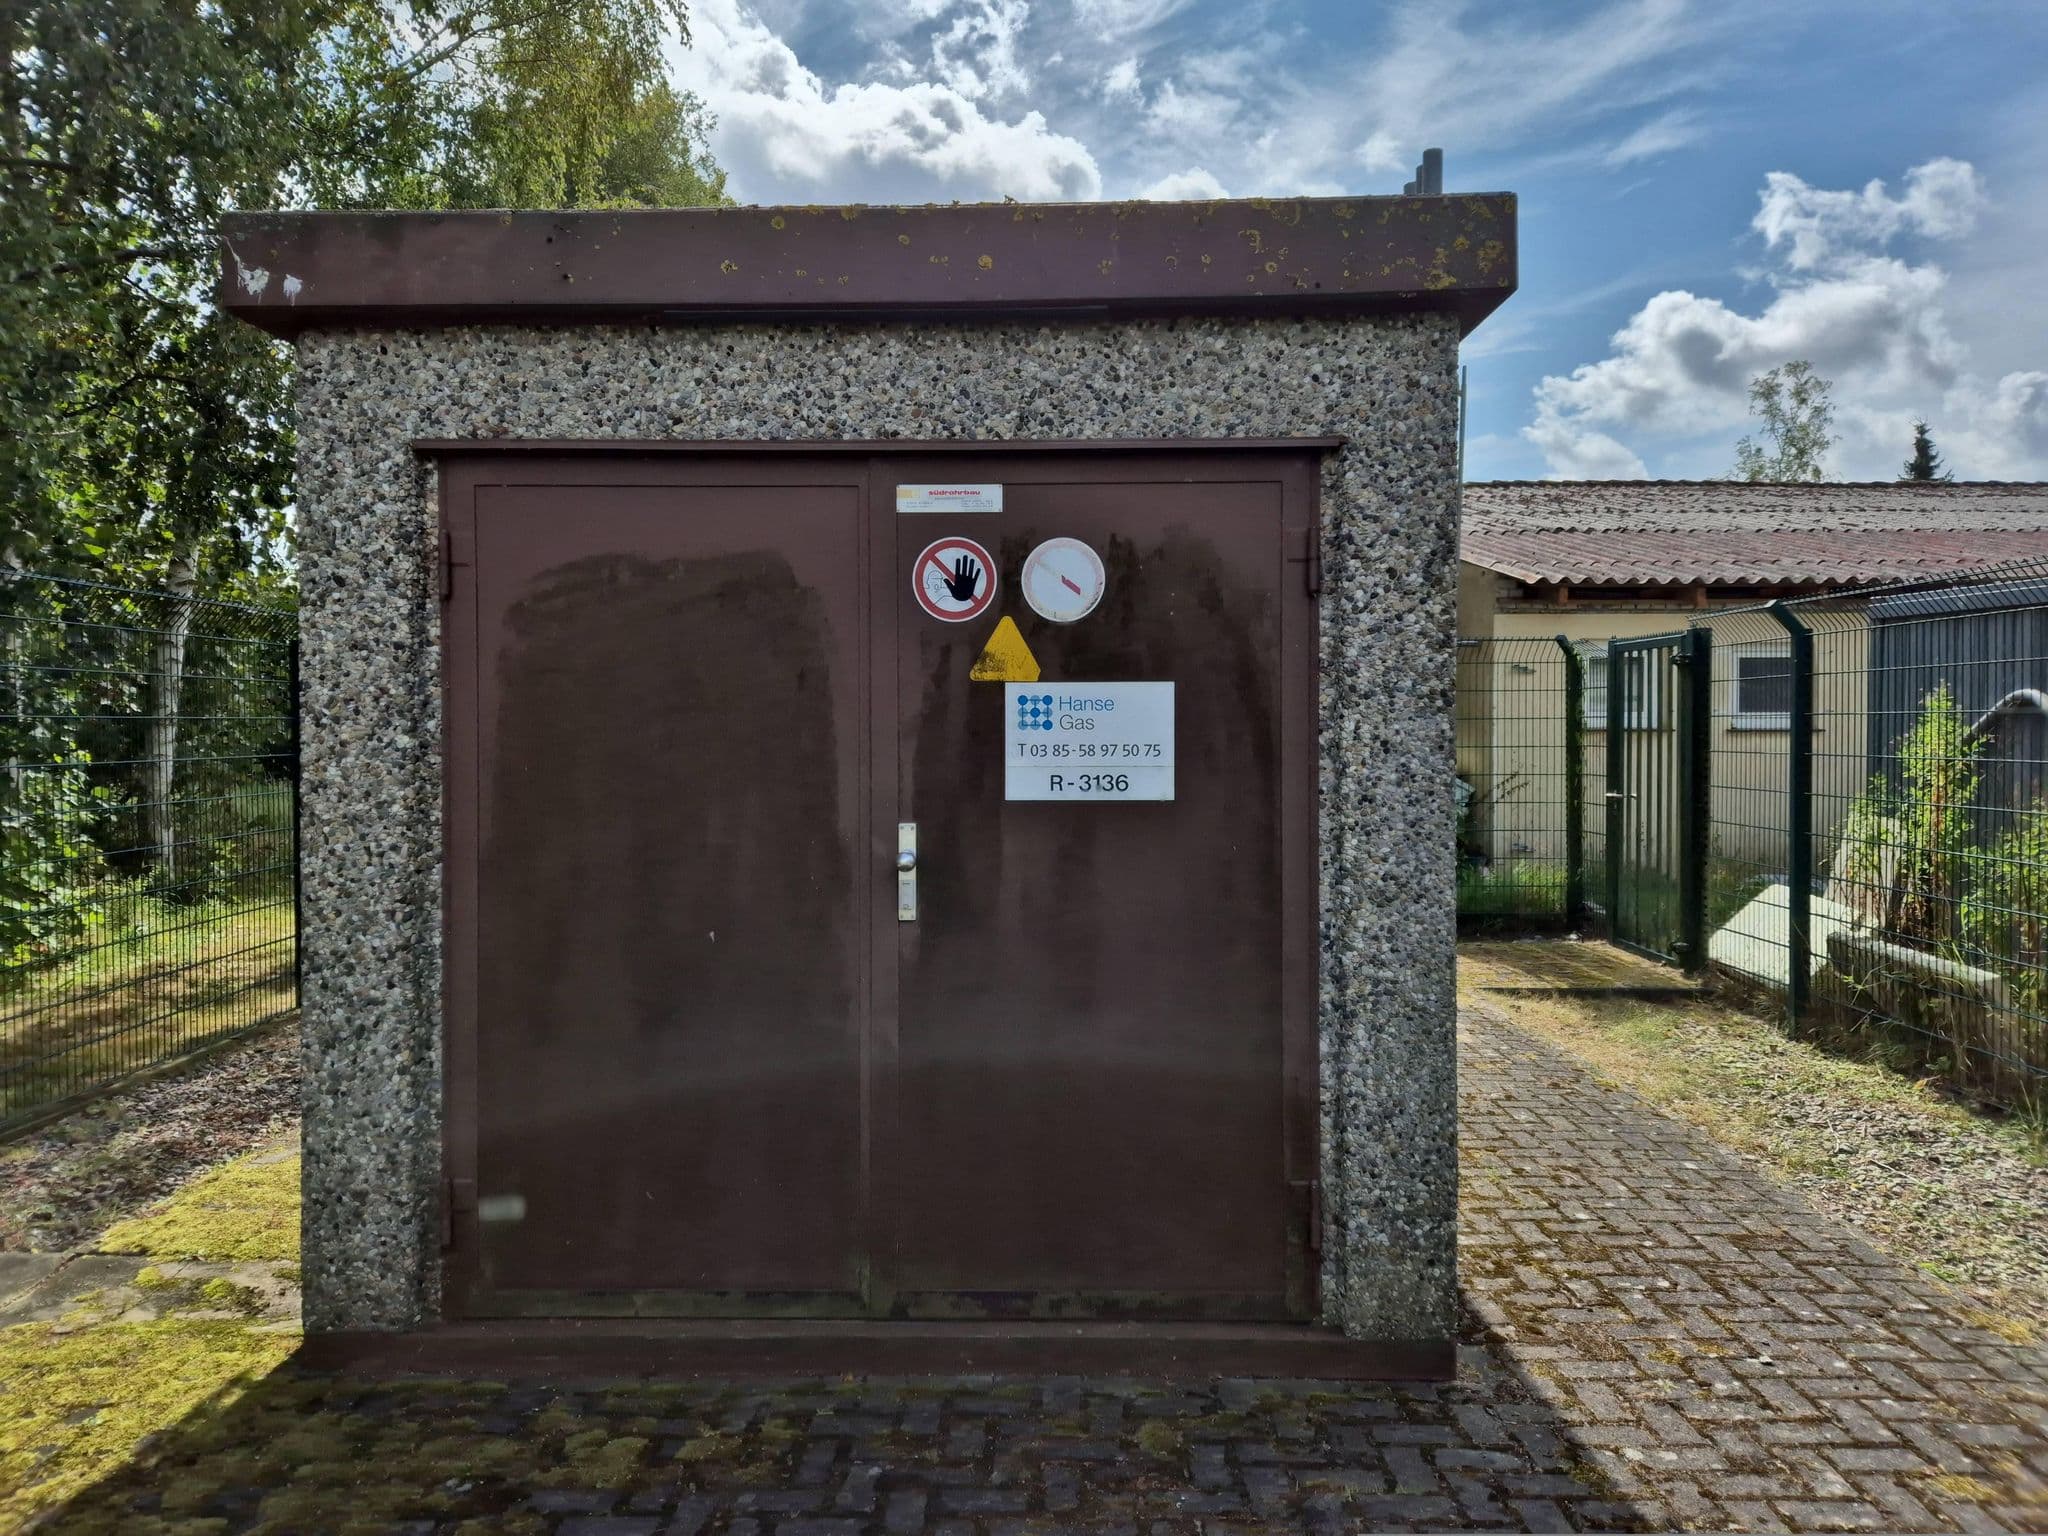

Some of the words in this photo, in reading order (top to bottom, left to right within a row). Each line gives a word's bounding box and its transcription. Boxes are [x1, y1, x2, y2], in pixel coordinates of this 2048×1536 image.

[1059, 695, 1115, 712] Hanse
[1059, 714, 1095, 730] Gas
[1018, 744, 1027, 757] T
[1030, 744, 1048, 757] 03
[1100, 744, 1118, 757] 97
[1122, 744, 1140, 757] 50
[1144, 744, 1161, 757] 75
